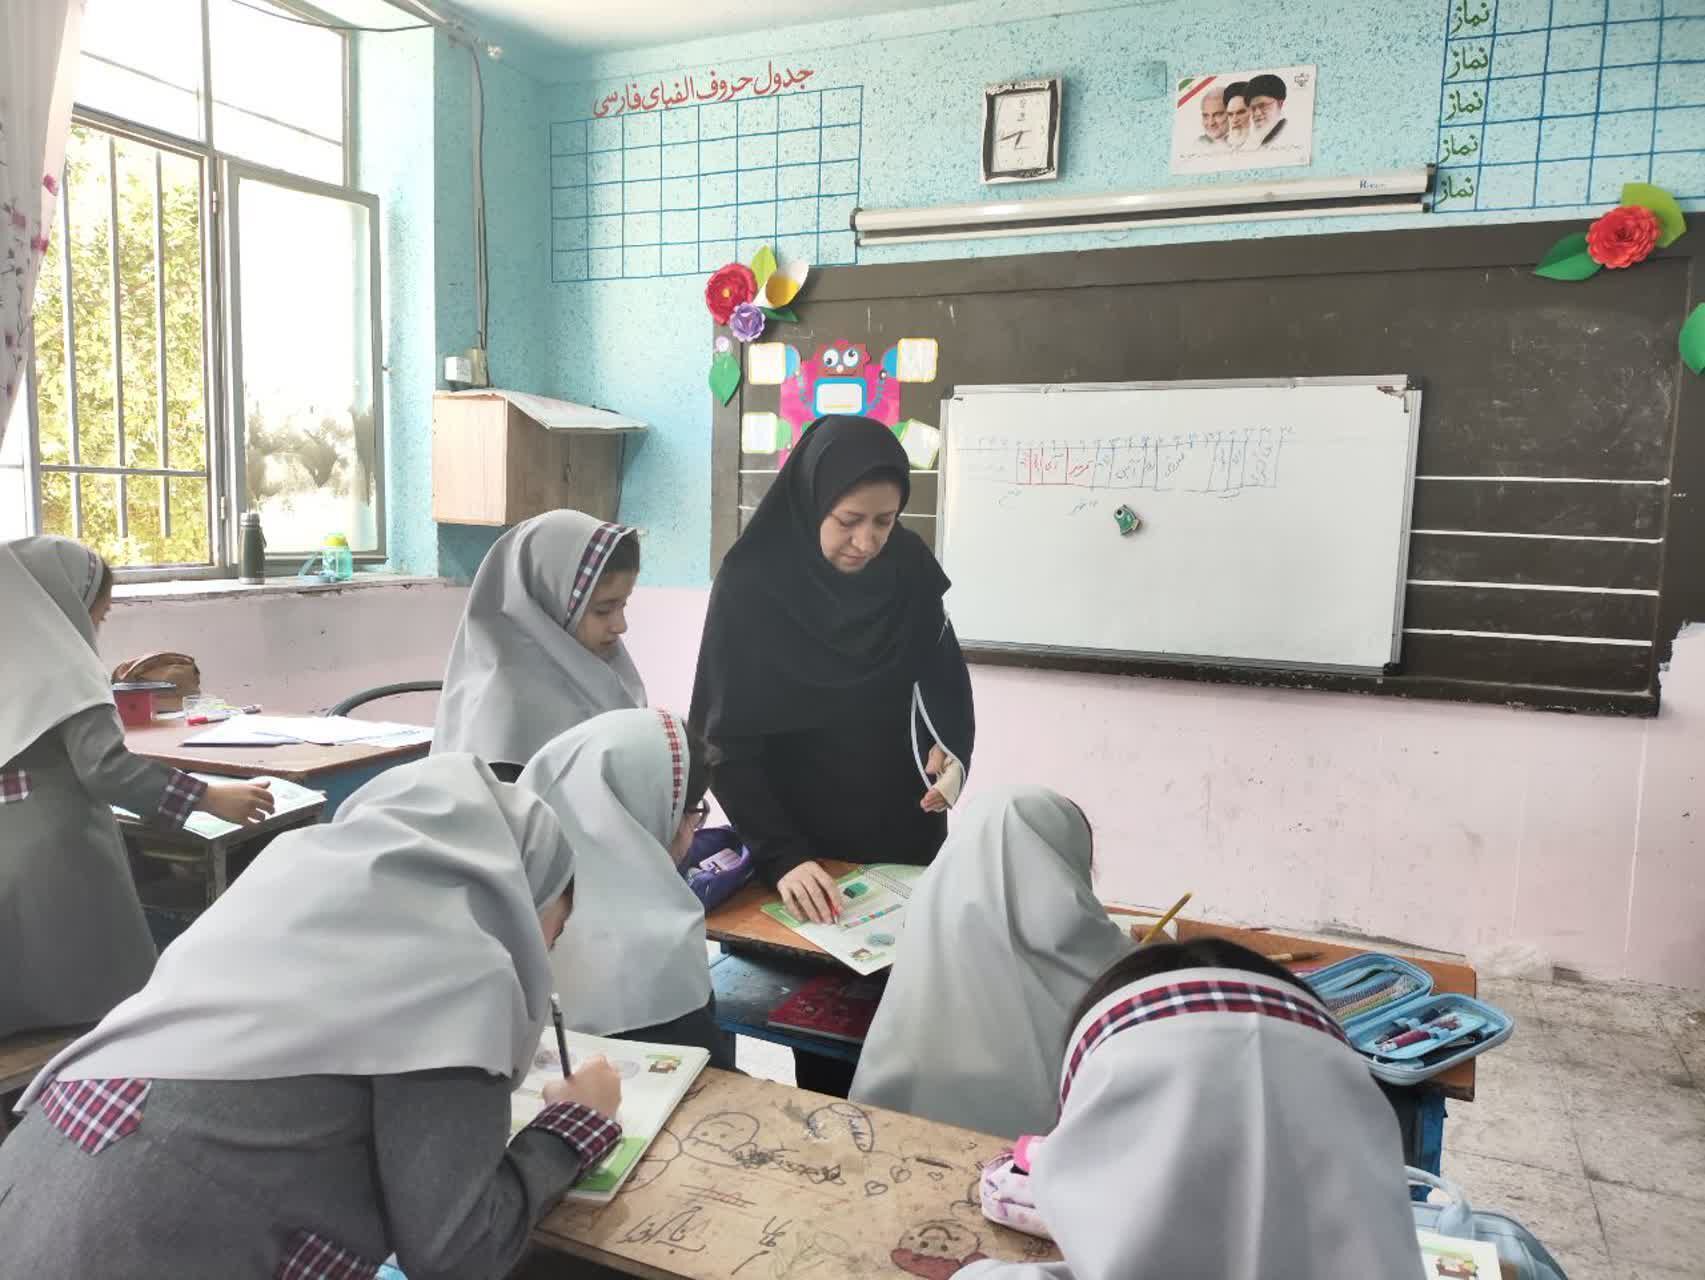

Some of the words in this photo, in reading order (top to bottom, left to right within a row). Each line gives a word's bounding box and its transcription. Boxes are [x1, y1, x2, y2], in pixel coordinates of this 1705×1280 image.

[1450, 0, 1490, 35] نماز
[754, 59, 814, 96] جدول
[1447, 45, 1489, 79] نماز
[593, 82, 641, 118] فارسی
[641, 75, 695, 110] الفبای
[696, 70, 754, 102] حروف
[1445, 89, 1484, 121] نماز
[1438, 134, 1479, 164] نماز
[1433, 175, 1475, 205] نماز
